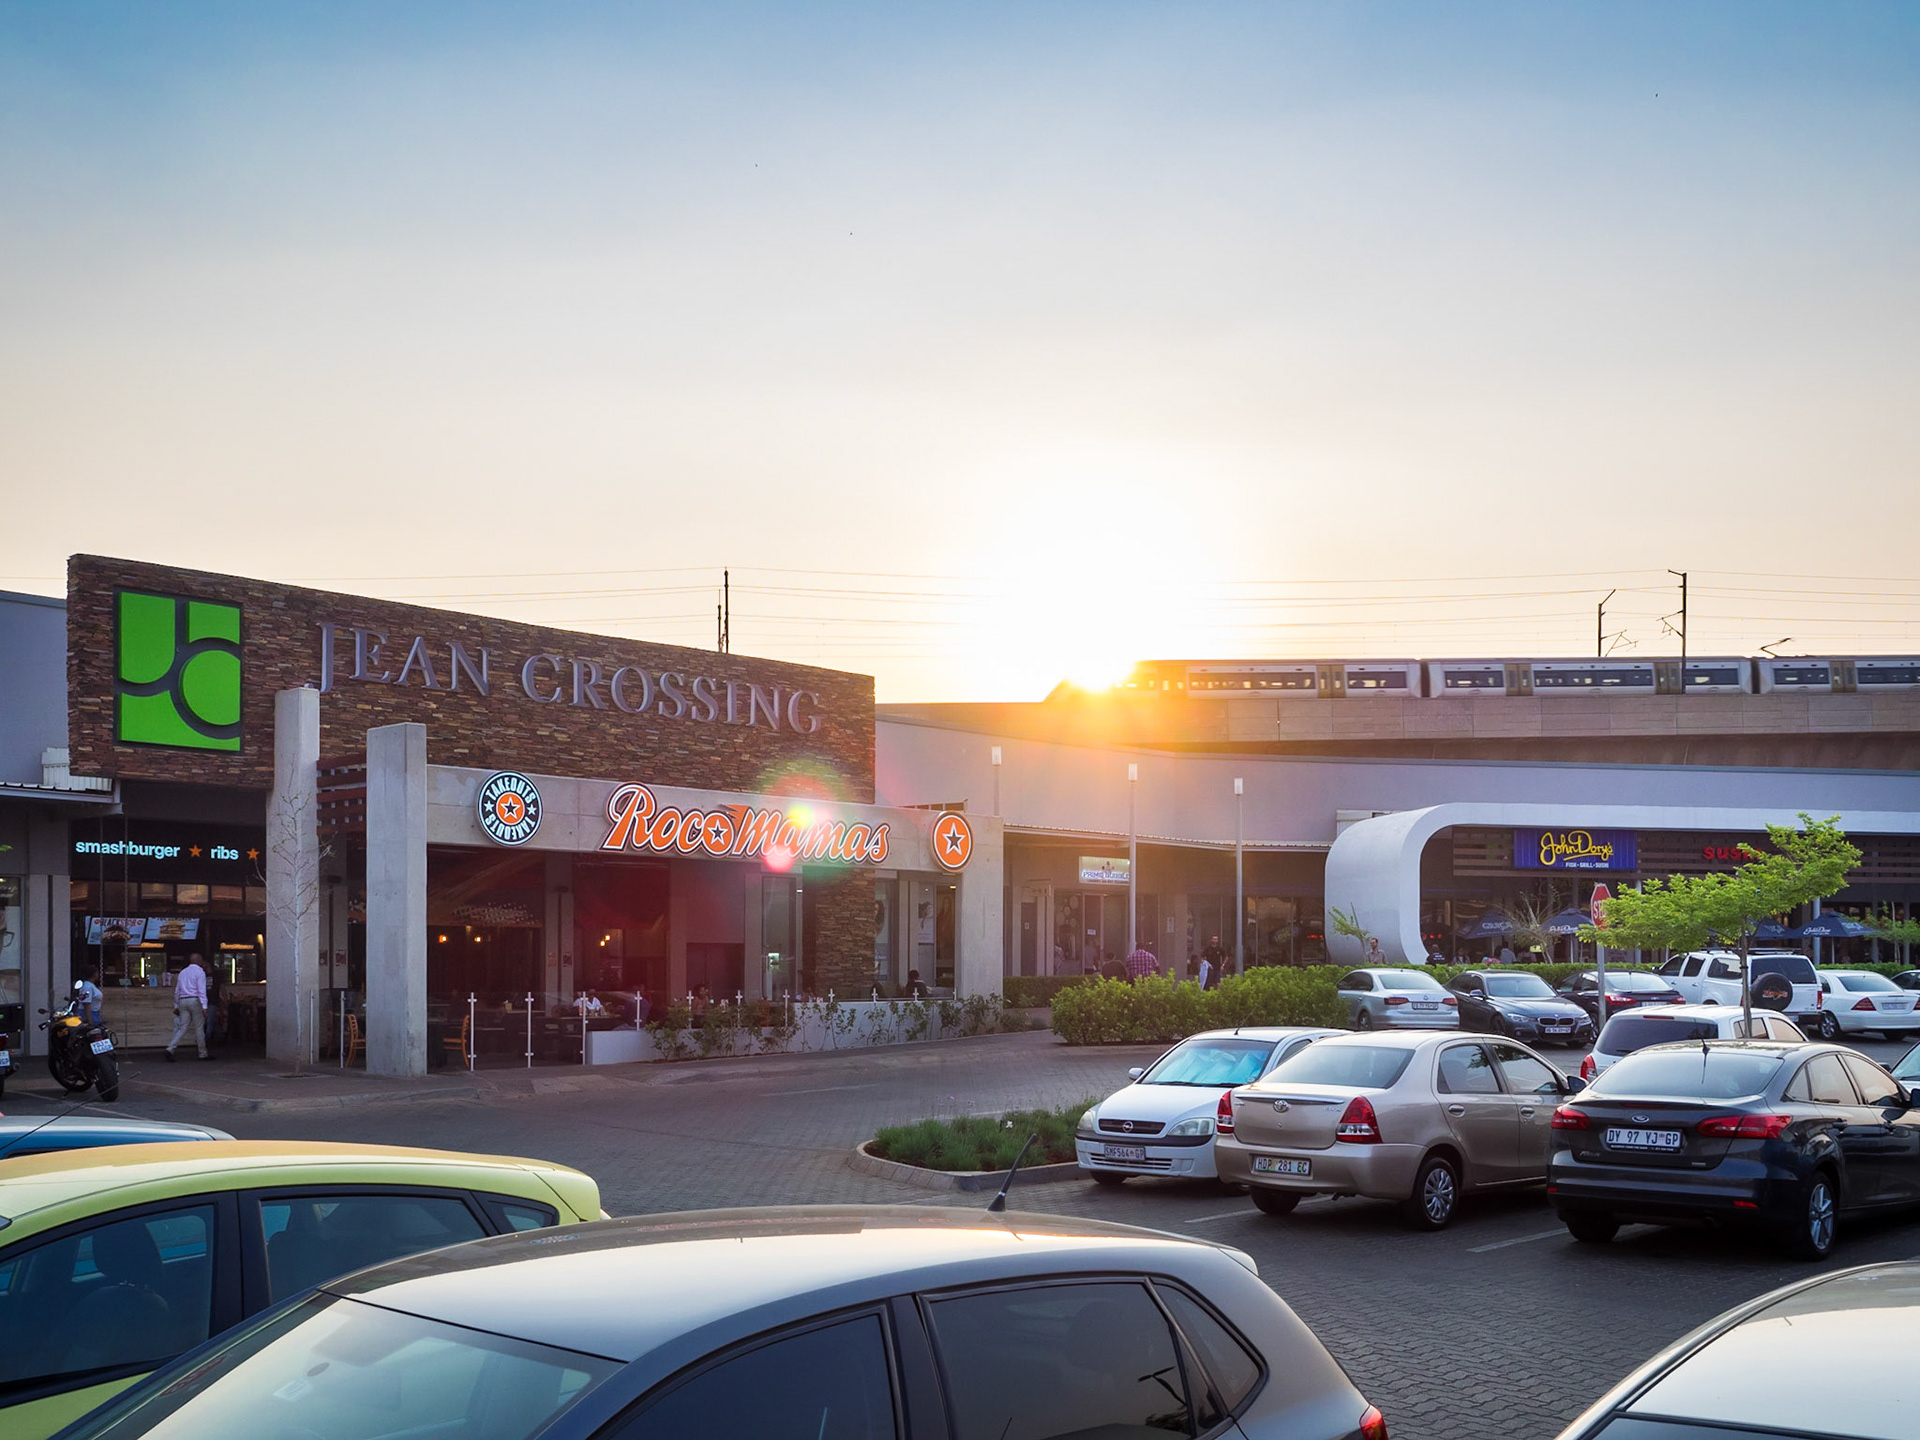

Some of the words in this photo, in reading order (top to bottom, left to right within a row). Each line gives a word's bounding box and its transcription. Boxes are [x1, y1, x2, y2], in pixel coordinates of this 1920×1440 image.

[304, 622, 493, 697] JEAN
[521, 653, 823, 735] CROSSING
[485, 776, 537, 805] TAKEOUTS
[484, 813, 537, 840] TAKEOUTS
[75, 840, 181, 860] smashburger
[210, 845, 239, 860] ribs
[1608, 1130, 1621, 1142] DY
[1627, 1131, 1640, 1143] 97
[1645, 1132, 1658, 1144] YJ
[1665, 1133, 1679, 1146] GP
[1134, 1148, 1145, 1160] GP
[1278, 1160, 1292, 1171] 281
[1297, 1161, 1307, 1173] EC
